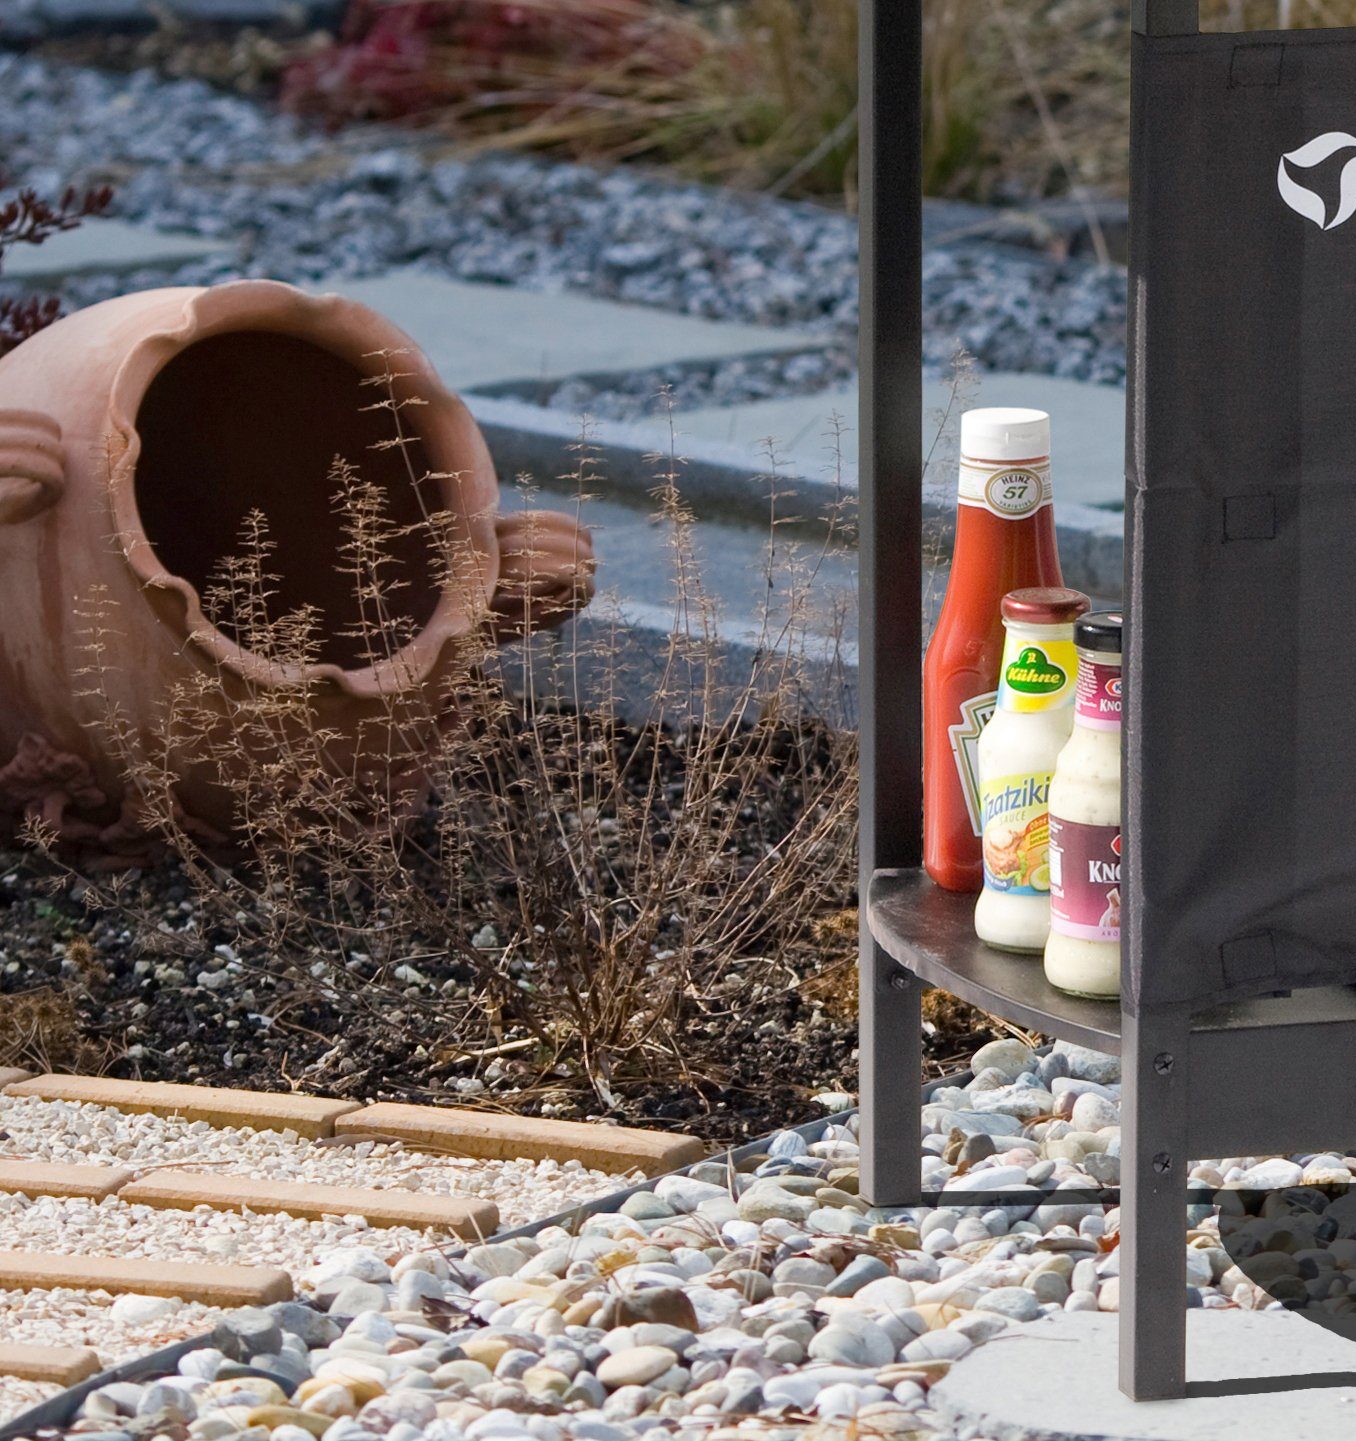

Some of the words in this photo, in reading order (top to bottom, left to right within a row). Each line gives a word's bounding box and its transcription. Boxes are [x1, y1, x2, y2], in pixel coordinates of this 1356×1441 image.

[1001, 475, 1031, 485] HEINZ
[1003, 485, 1029, 499] 57
[1008, 668, 1060, 683] Kühne
